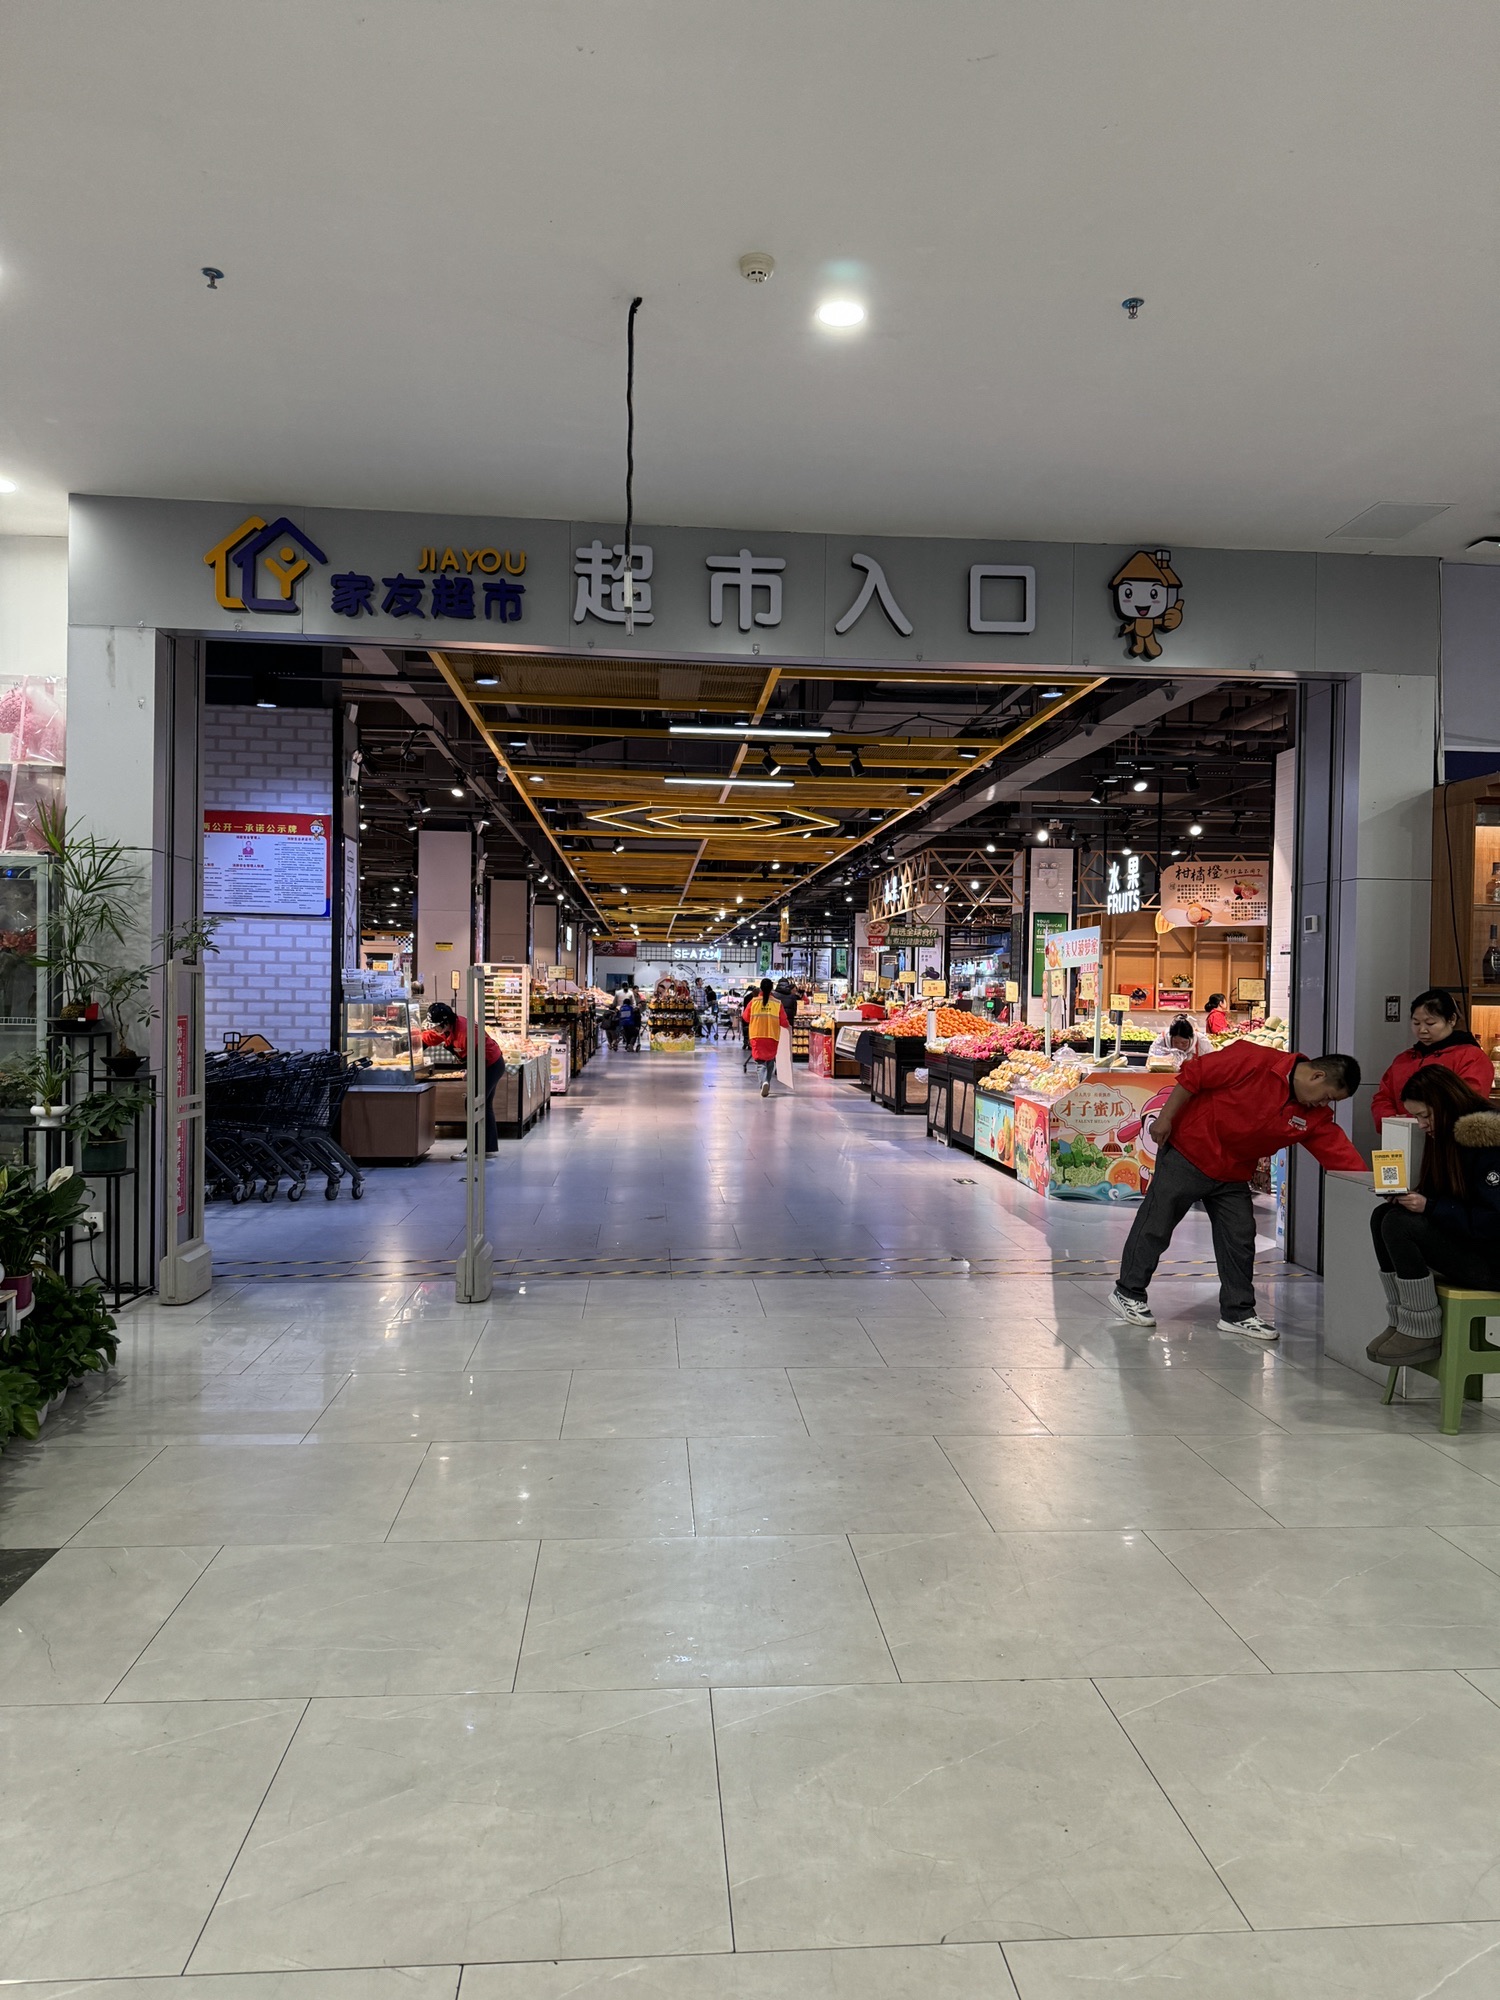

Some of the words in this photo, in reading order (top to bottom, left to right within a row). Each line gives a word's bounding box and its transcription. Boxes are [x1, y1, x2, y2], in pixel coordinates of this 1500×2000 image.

[417, 547, 528, 576] JIAYOU
[329, 570, 527, 624] 家友超市
[573, 539, 1038, 637] 超市入口
[1108, 855, 1141, 894] 水果
[1175, 864, 1222, 884] 柑橘橙
[1107, 889, 1140, 915] FRUITS
[1060, 1099, 1125, 1117] 才子蜜瓜
